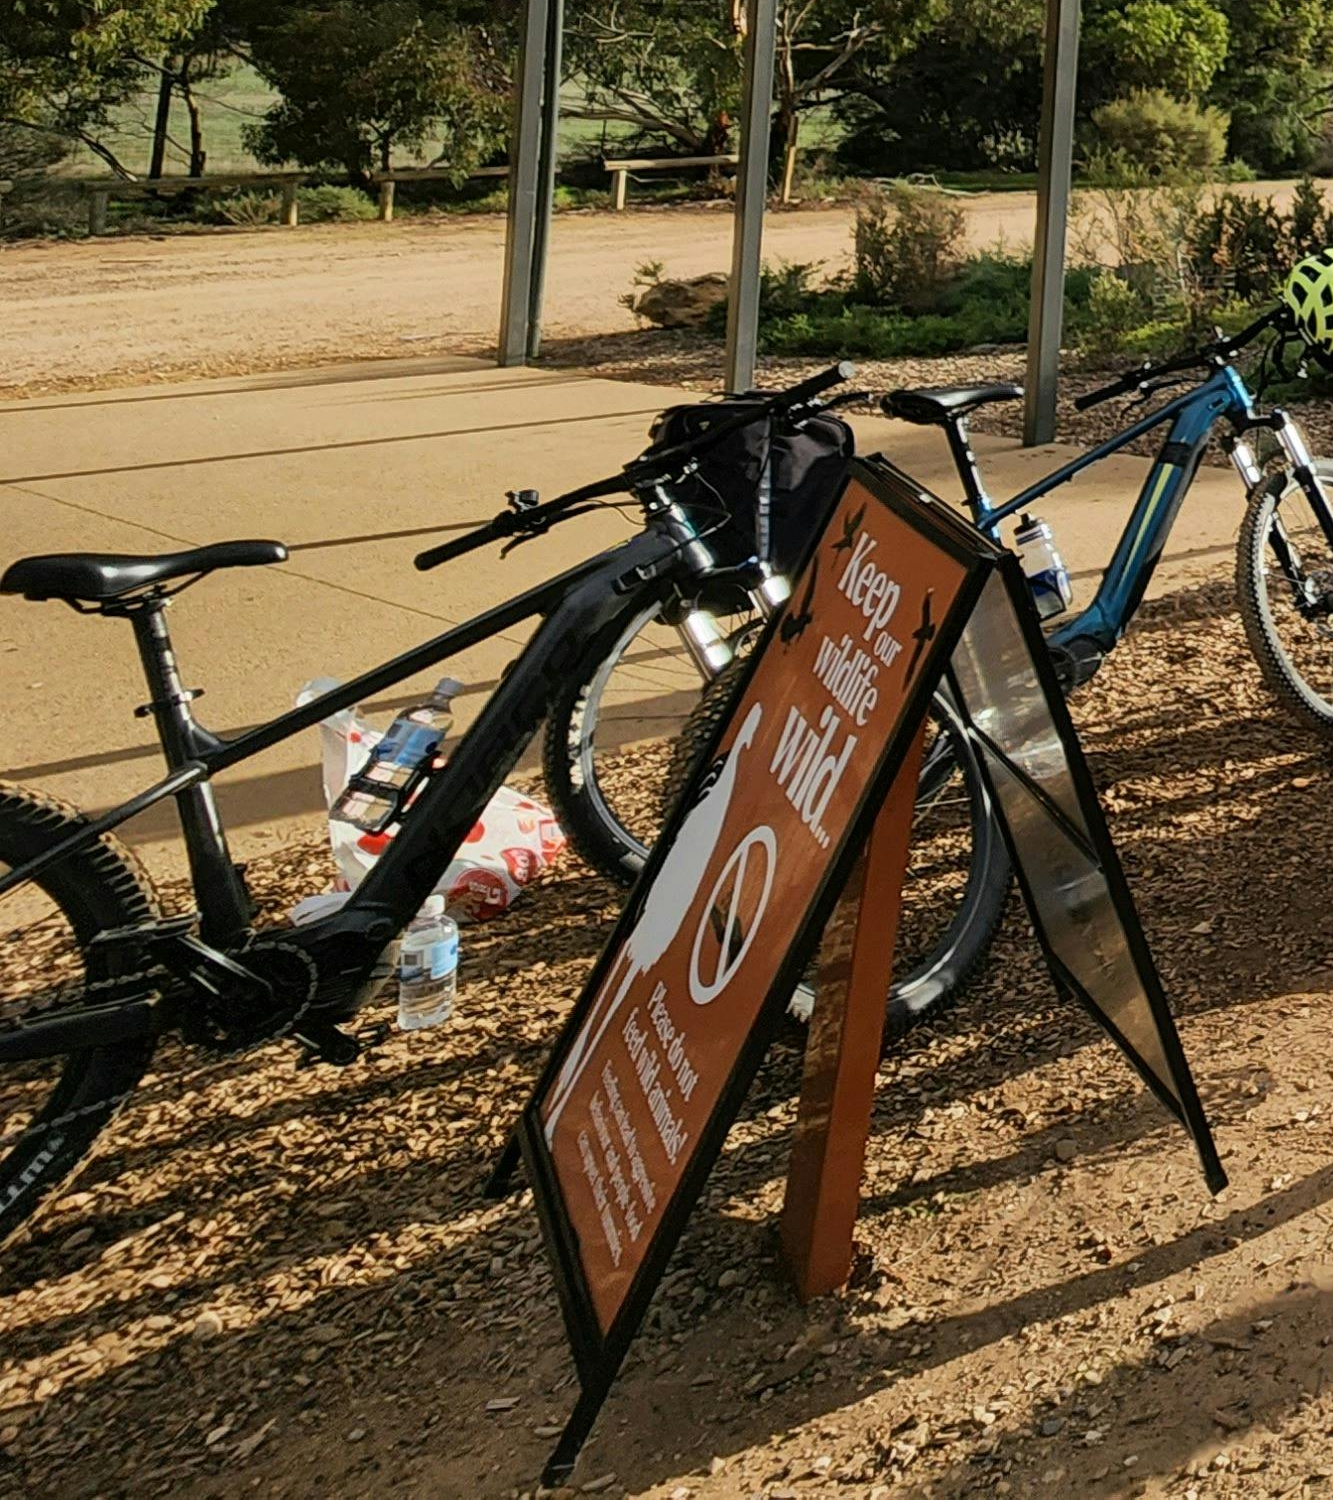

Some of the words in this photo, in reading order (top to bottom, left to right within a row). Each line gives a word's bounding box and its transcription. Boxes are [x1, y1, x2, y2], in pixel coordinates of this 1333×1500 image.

[838, 532, 901, 641] Keep
[875, 631, 903, 668] our
[812, 634, 880, 727] wildlife
[769, 705, 858, 849] wild...
[622, 1007, 648, 1062] feed
[635, 1047, 661, 1094] wild
[647, 981, 675, 1049] Please
[667, 1032, 685, 1071] do
[676, 1058, 699, 1102] not
[647, 1081, 688, 1165] animals!
